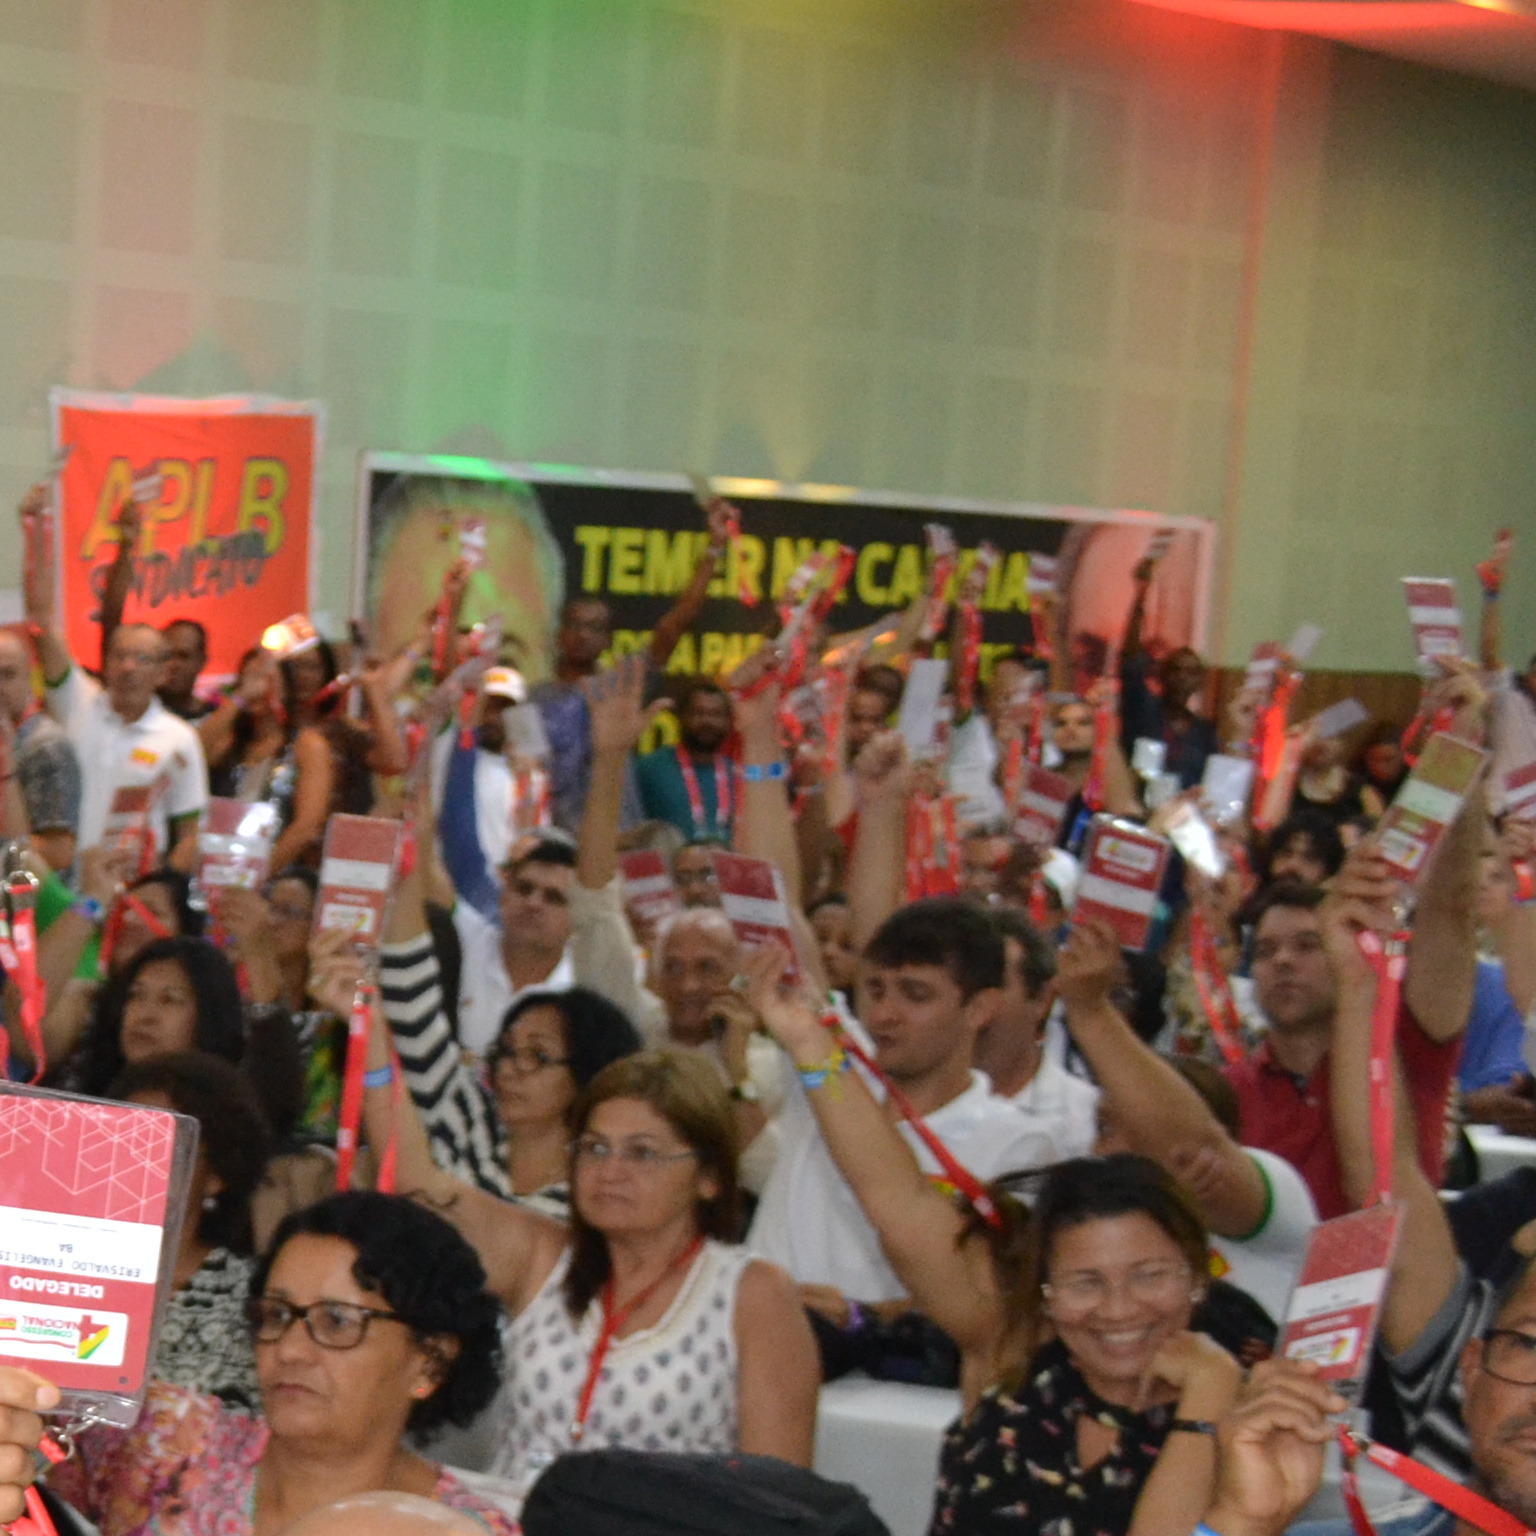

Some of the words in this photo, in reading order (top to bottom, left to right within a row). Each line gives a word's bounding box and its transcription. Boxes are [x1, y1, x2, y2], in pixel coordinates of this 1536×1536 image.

[80, 456, 289, 560] APLB
[59, 1243, 73, 1253] BA
[72, 1260, 141, 1278] ERISVALDO
[9, 1275, 104, 1299] DELEGADO
[22, 1315, 80, 1330] NACIONAL
[21, 1325, 73, 1338] CONGRESSO
